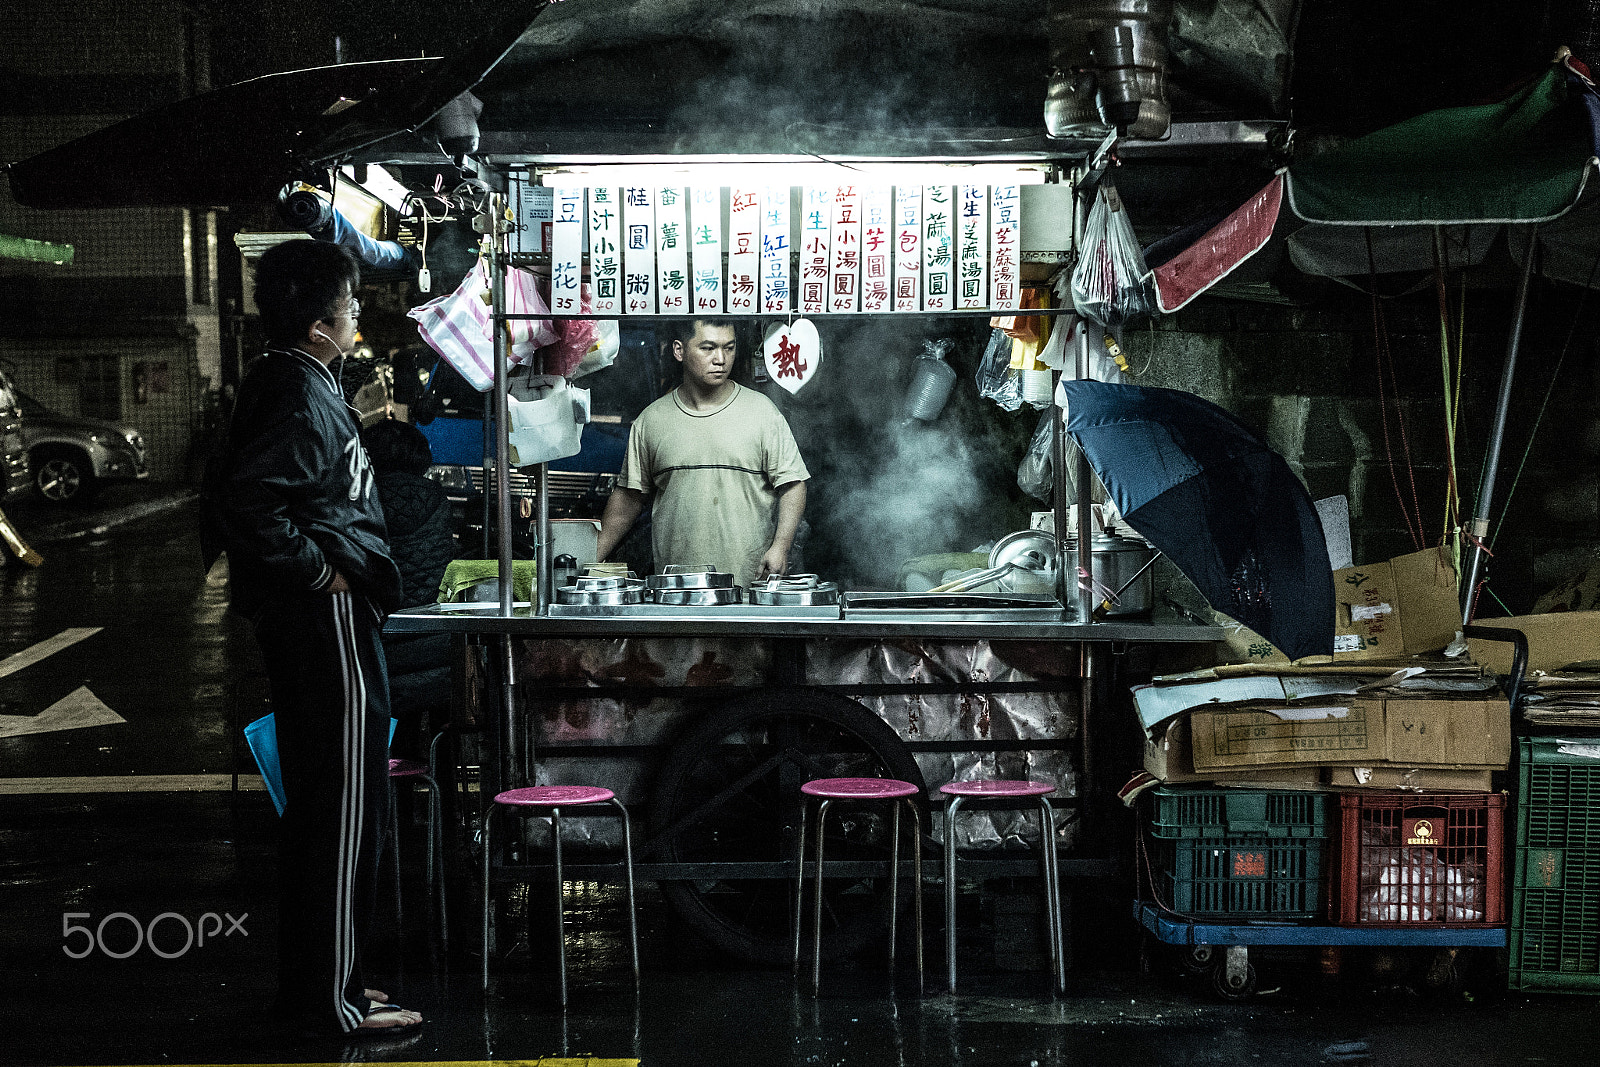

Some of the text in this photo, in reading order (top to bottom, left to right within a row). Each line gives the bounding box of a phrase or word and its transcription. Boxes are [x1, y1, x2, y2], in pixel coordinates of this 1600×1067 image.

[554, 197, 580, 289] 豆花
[627, 187, 649, 296] 桂圓粥
[732, 189, 757, 296] 紅豆湯
[834, 186, 858, 295] 紅豆小湯圓
[896, 187, 920, 298] 紅豆包心圓
[556, 297, 574, 309] 35
[596, 300, 614, 311] 40
[630, 299, 647, 311] 40
[664, 296, 682, 308] 45
[698, 297, 717, 309] 40
[732, 297, 751, 308] 40
[766, 301, 784, 312] 45
[804, 303, 822, 313] 45
[834, 298, 852, 310] 45
[865, 301, 882, 310] 45
[897, 300, 913, 311] 45
[928, 298, 944, 308] 45
[963, 299, 979, 308] 70
[996, 301, 1012, 311] 70
[772, 334, 808, 380] 熱
